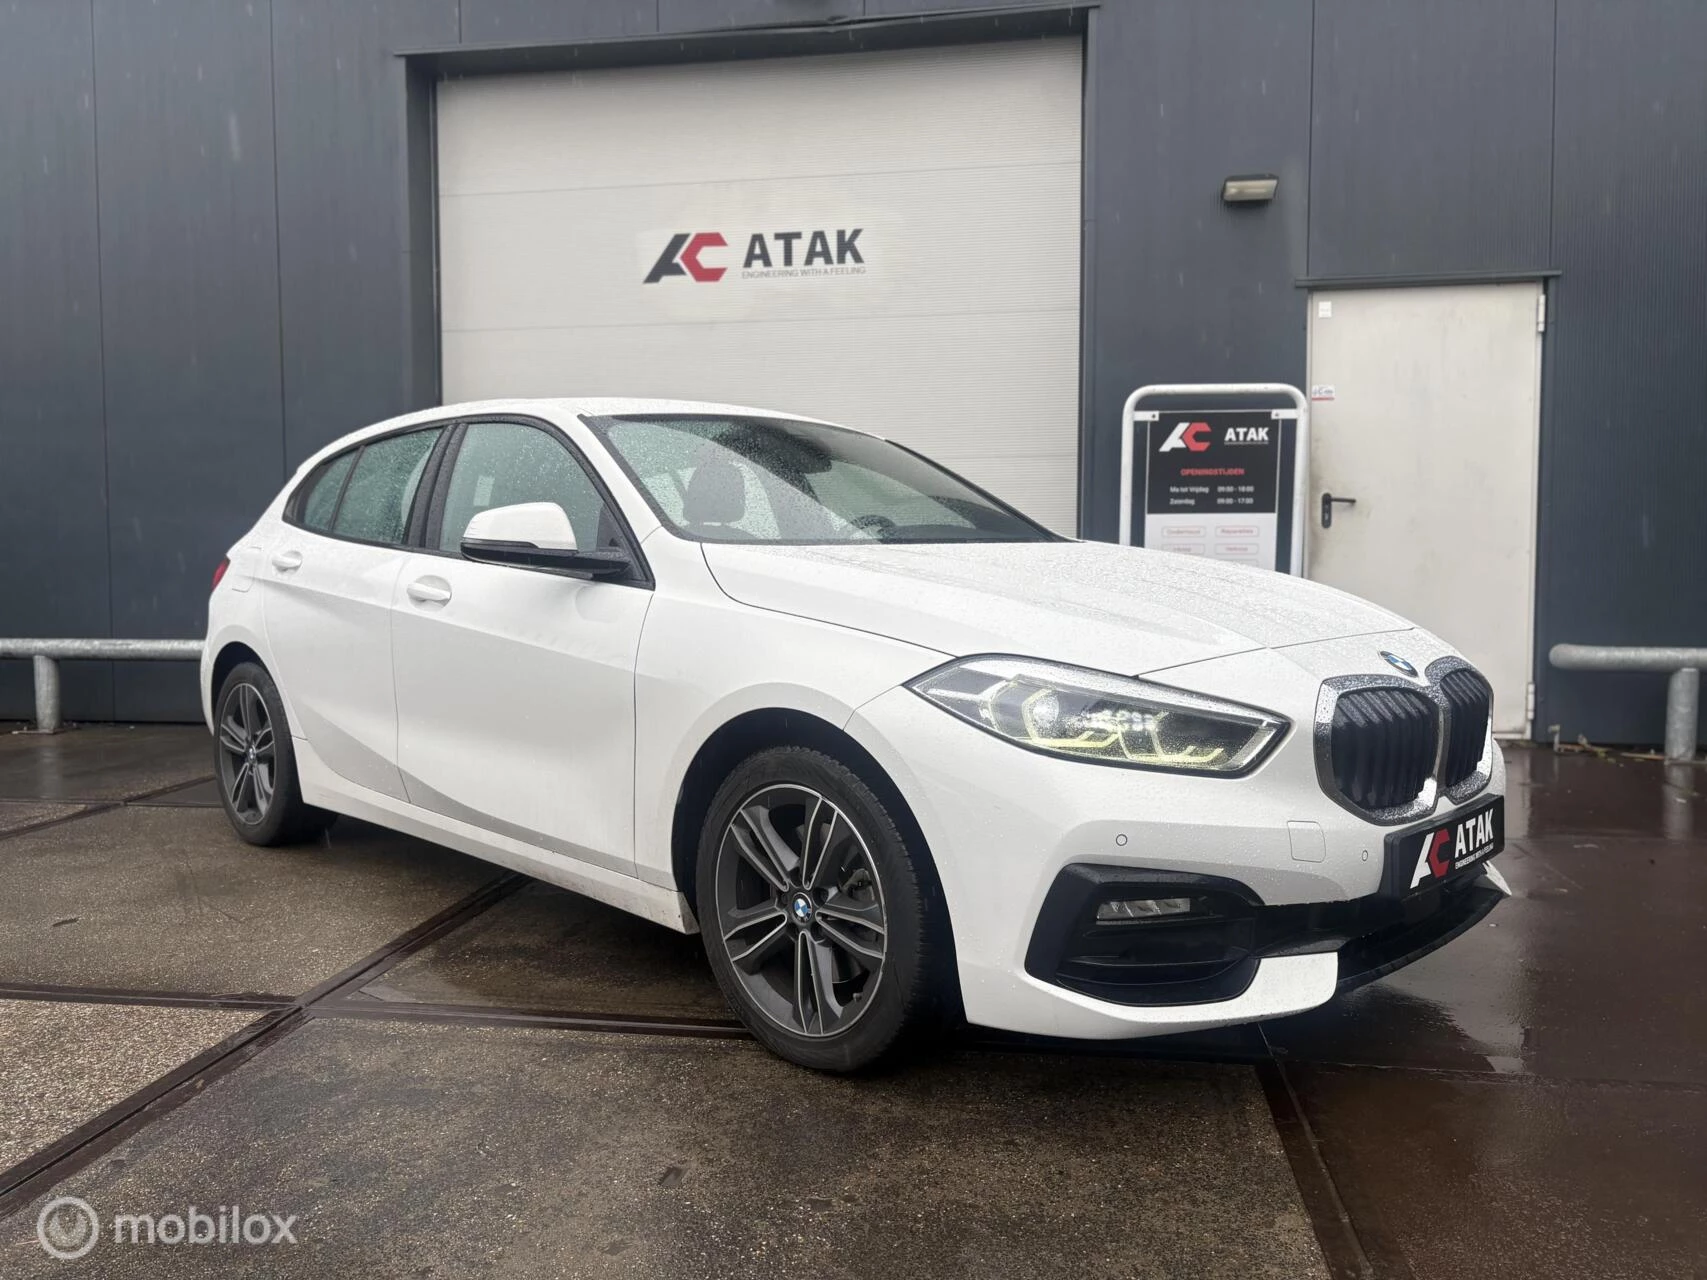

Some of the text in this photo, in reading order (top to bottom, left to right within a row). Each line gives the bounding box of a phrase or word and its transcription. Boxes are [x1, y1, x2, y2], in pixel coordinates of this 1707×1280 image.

[742, 228, 865, 269] ATAK
[742, 269, 799, 280] ENGINEERING
[800, 268, 822, 277] WITH
[1224, 427, 1269, 441] ATAK
[1455, 808, 1493, 858] ATAK
